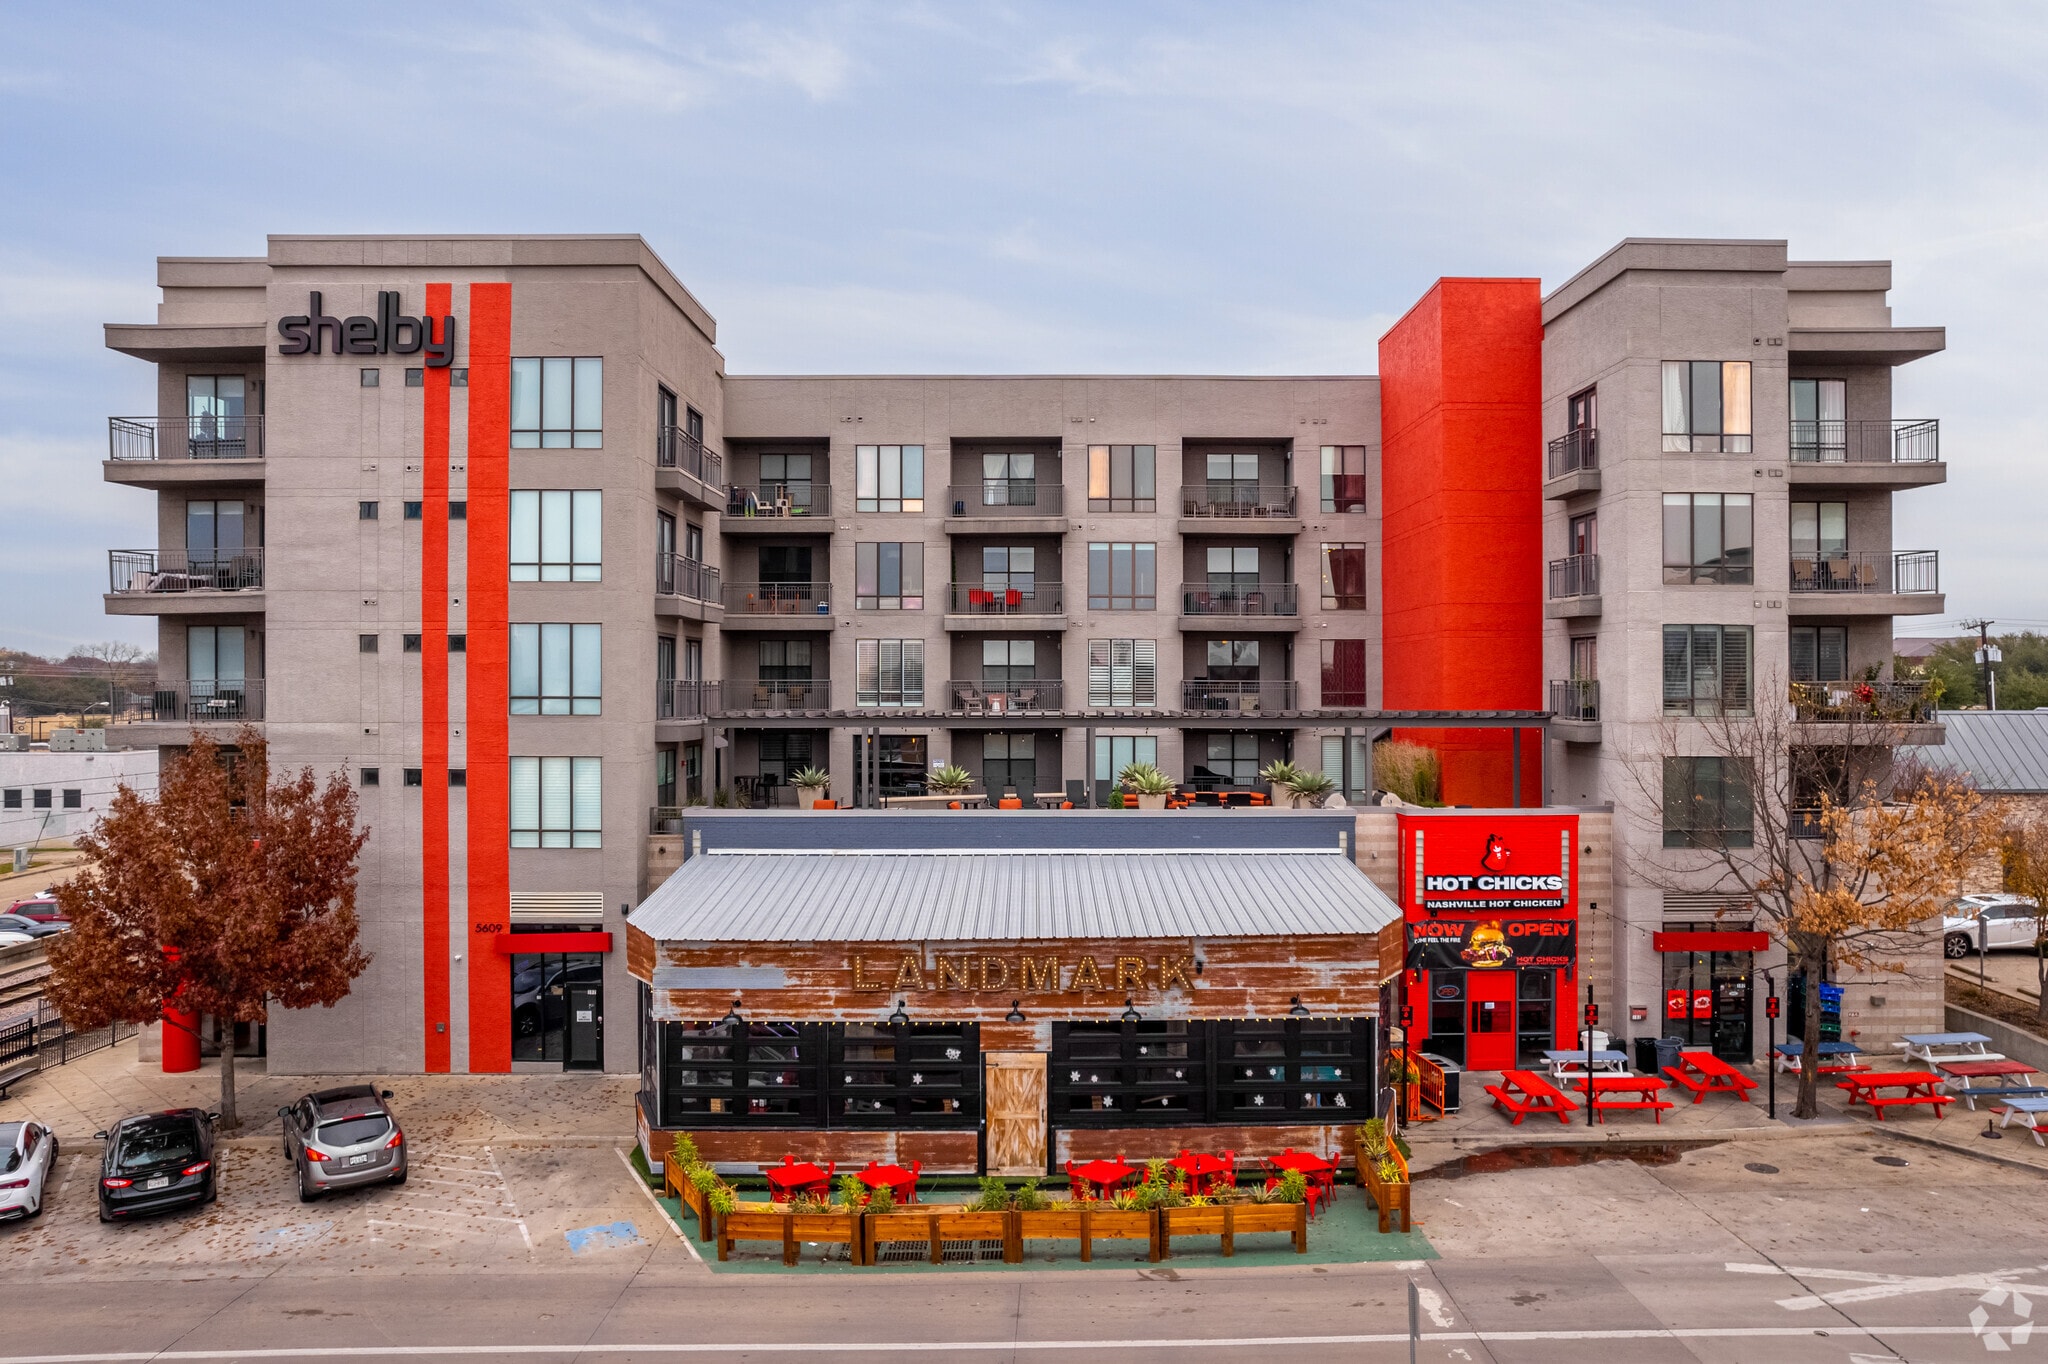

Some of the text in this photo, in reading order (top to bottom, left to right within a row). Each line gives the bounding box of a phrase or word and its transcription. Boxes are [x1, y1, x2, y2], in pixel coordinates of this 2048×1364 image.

[278, 291, 454, 367] shelby
[1427, 876, 1562, 891] HOT CHICKS
[1427, 899, 1561, 908] NASHVILLE HOT CHICKEN
[475, 924, 502, 933] 5609
[1413, 923, 1568, 938] NOW OPEN
[852, 954, 1196, 993] LANDMARK
